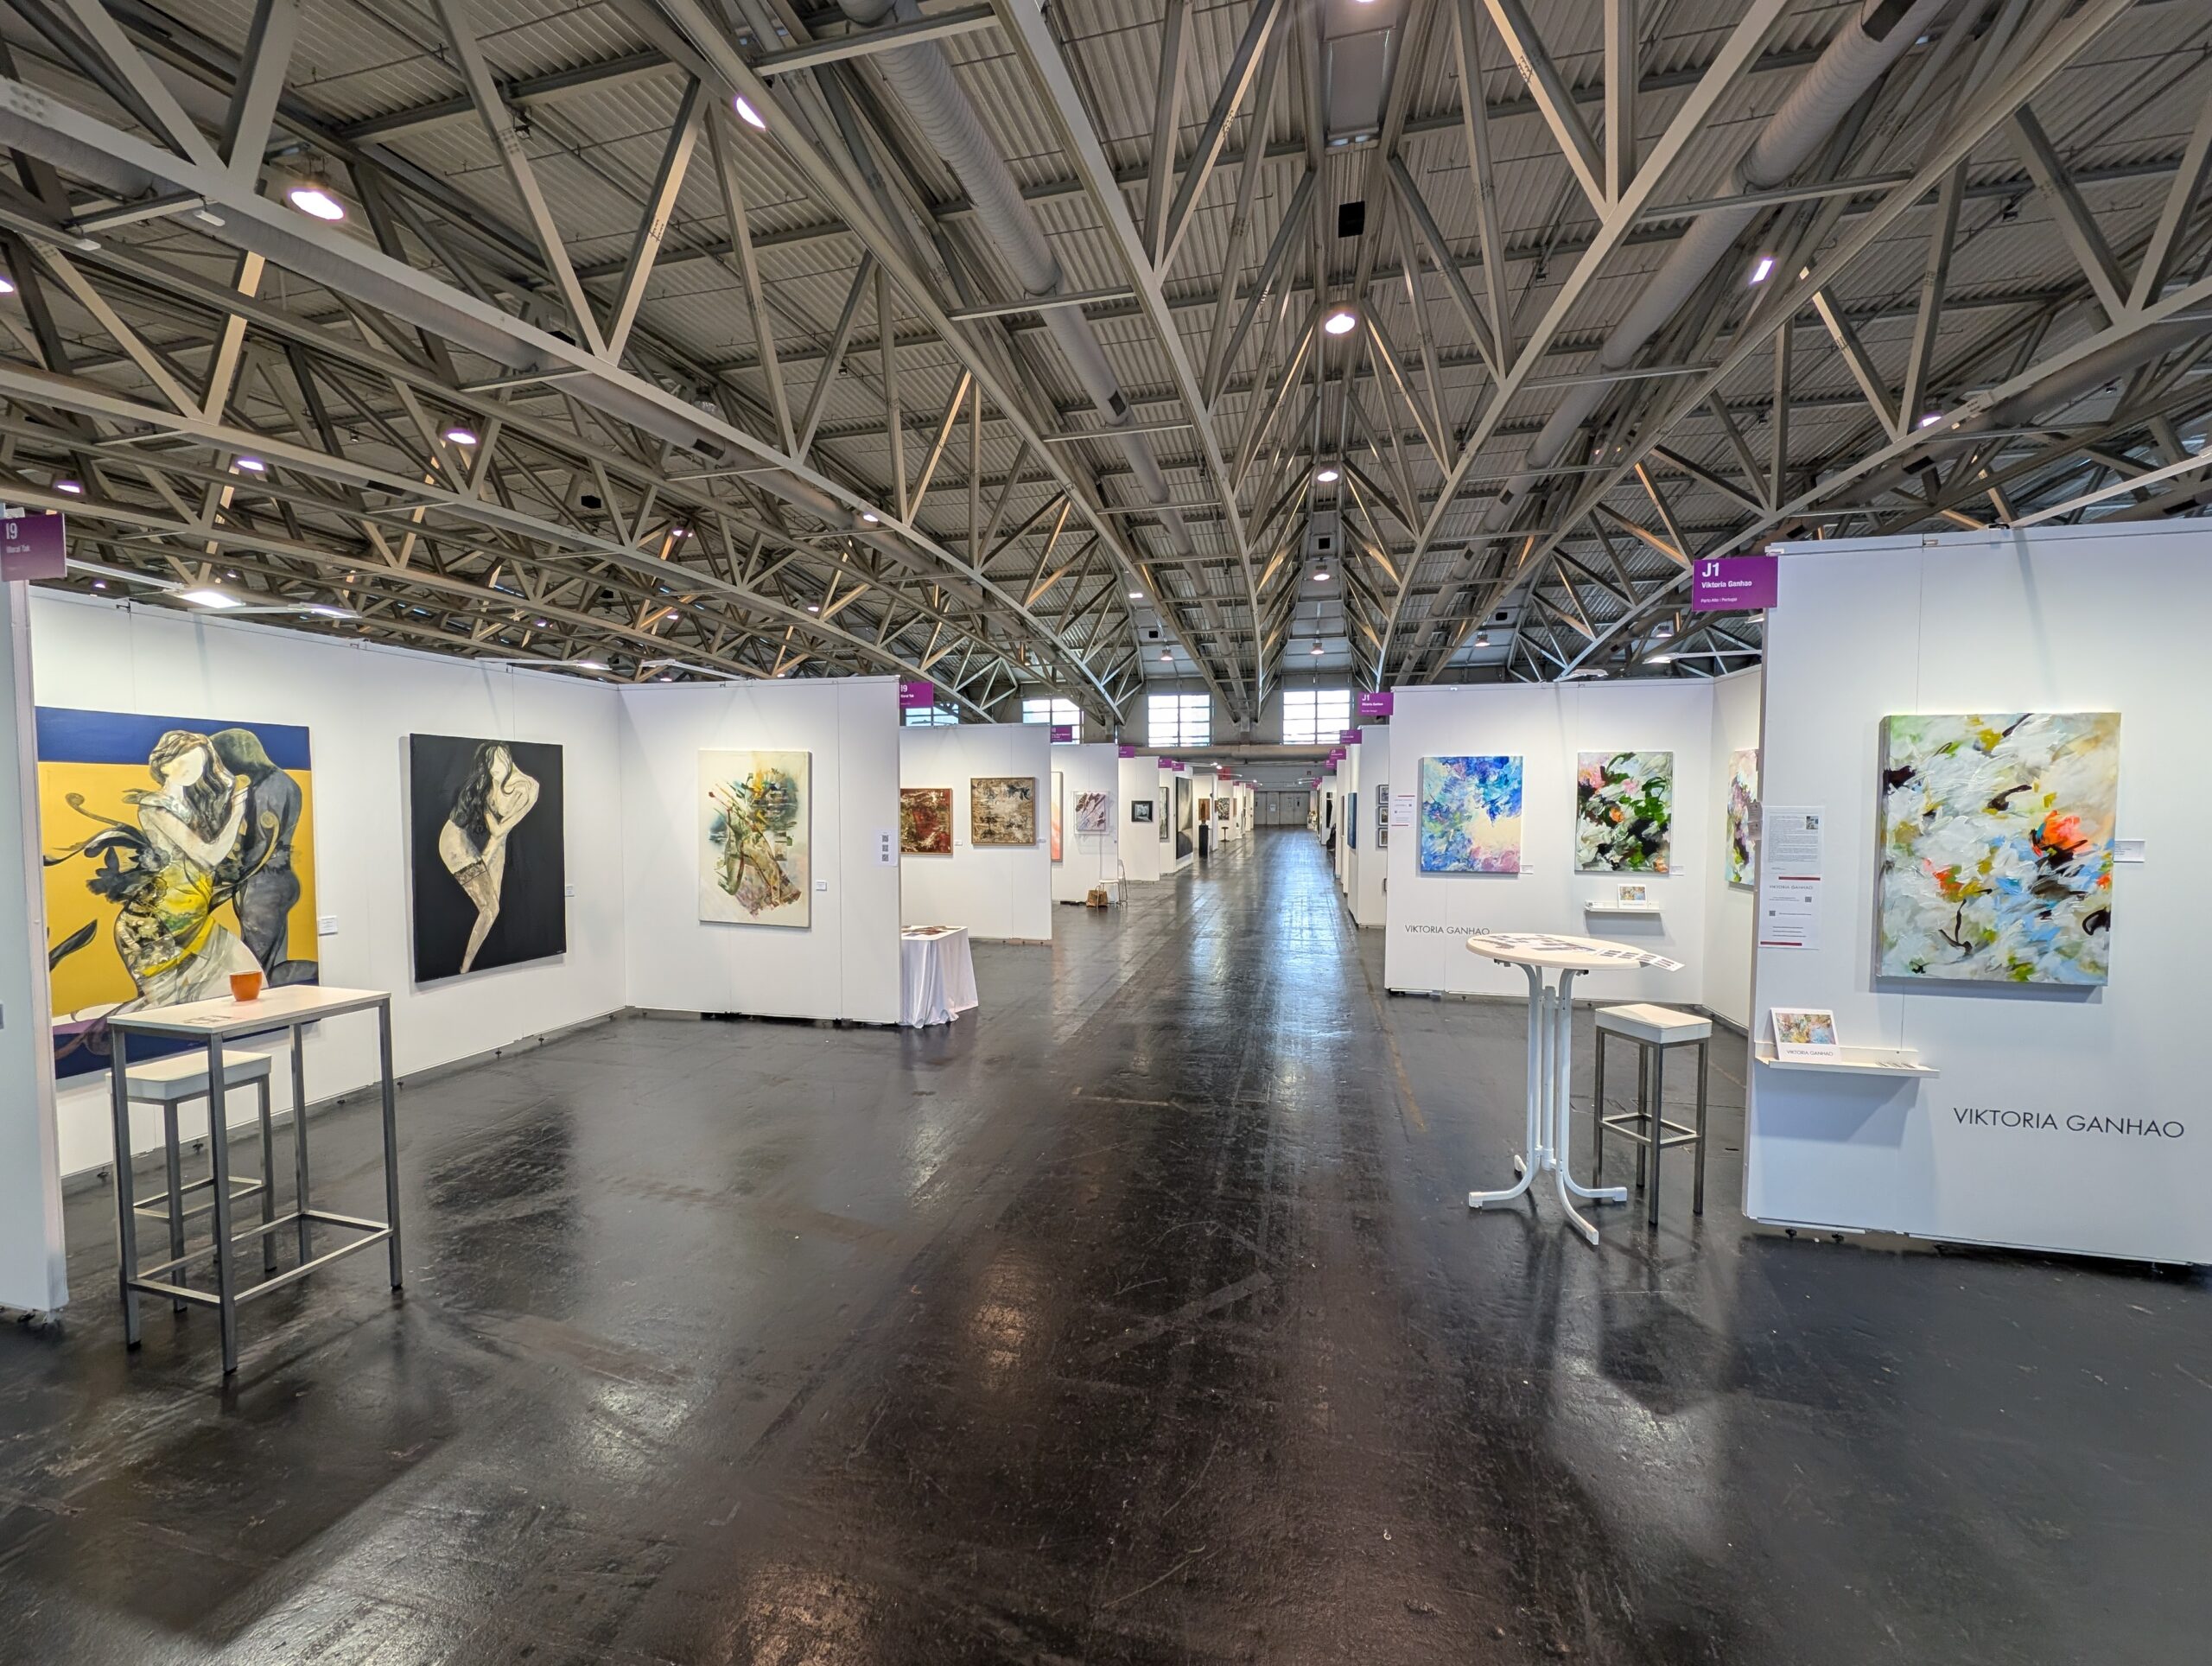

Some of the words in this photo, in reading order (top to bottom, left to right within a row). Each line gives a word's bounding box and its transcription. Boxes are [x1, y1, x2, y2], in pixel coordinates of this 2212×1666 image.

[1701, 563, 1719, 577] J1
[1404, 925, 1445, 934] VIKTORIA
[1446, 925, 1491, 936] GANHAO
[1953, 1107, 2058, 1130] VIKTORIA
[2066, 1115, 2185, 1138] GANHAO
